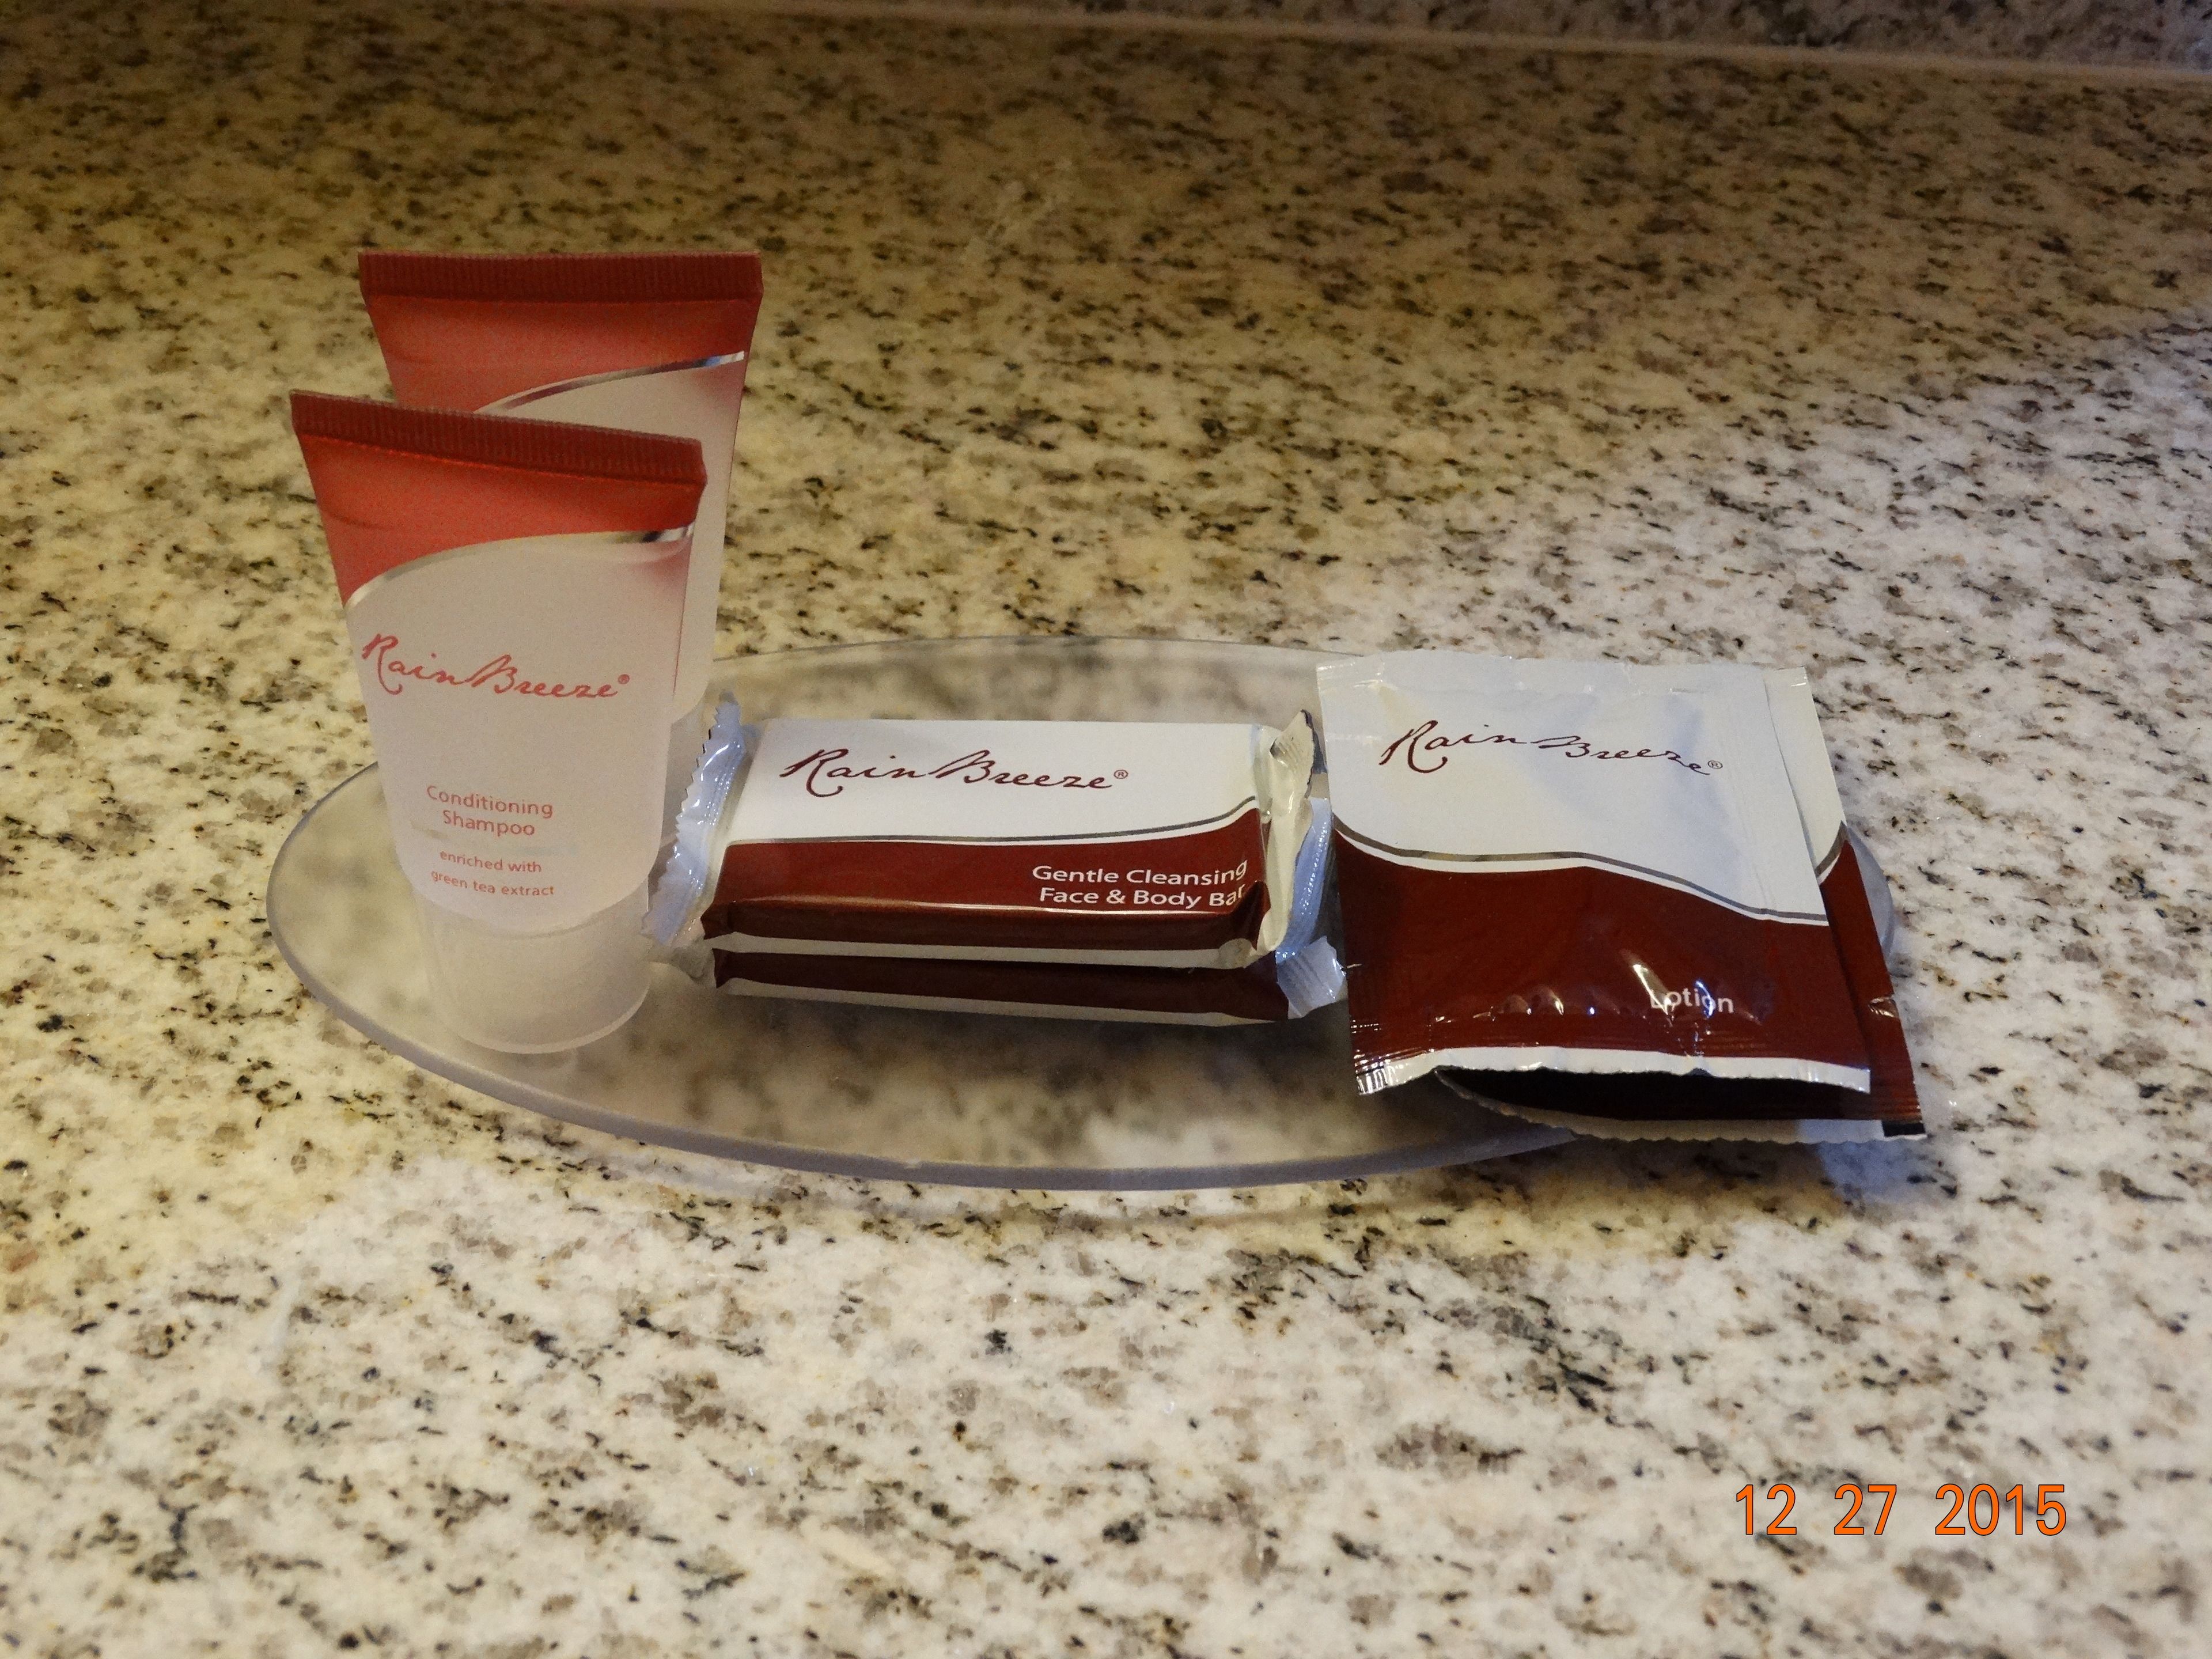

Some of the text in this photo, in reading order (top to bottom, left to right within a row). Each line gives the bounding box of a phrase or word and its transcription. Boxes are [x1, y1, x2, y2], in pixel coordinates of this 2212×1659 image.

[362, 634, 463, 695] Rain
[1378, 719, 1528, 774] Rain
[779, 748, 925, 798] Rain
[427, 785, 552, 819] Conditioning
[442, 809, 535, 836] Shampoo
[440, 851, 542, 872] enriched with
[1032, 859, 1248, 886] Gentle Cleansing
[431, 870, 554, 896] green tea extract
[1040, 887, 1099, 904] Face
[1105, 889, 1126, 904] &
[1133, 889, 1202, 909] Body
